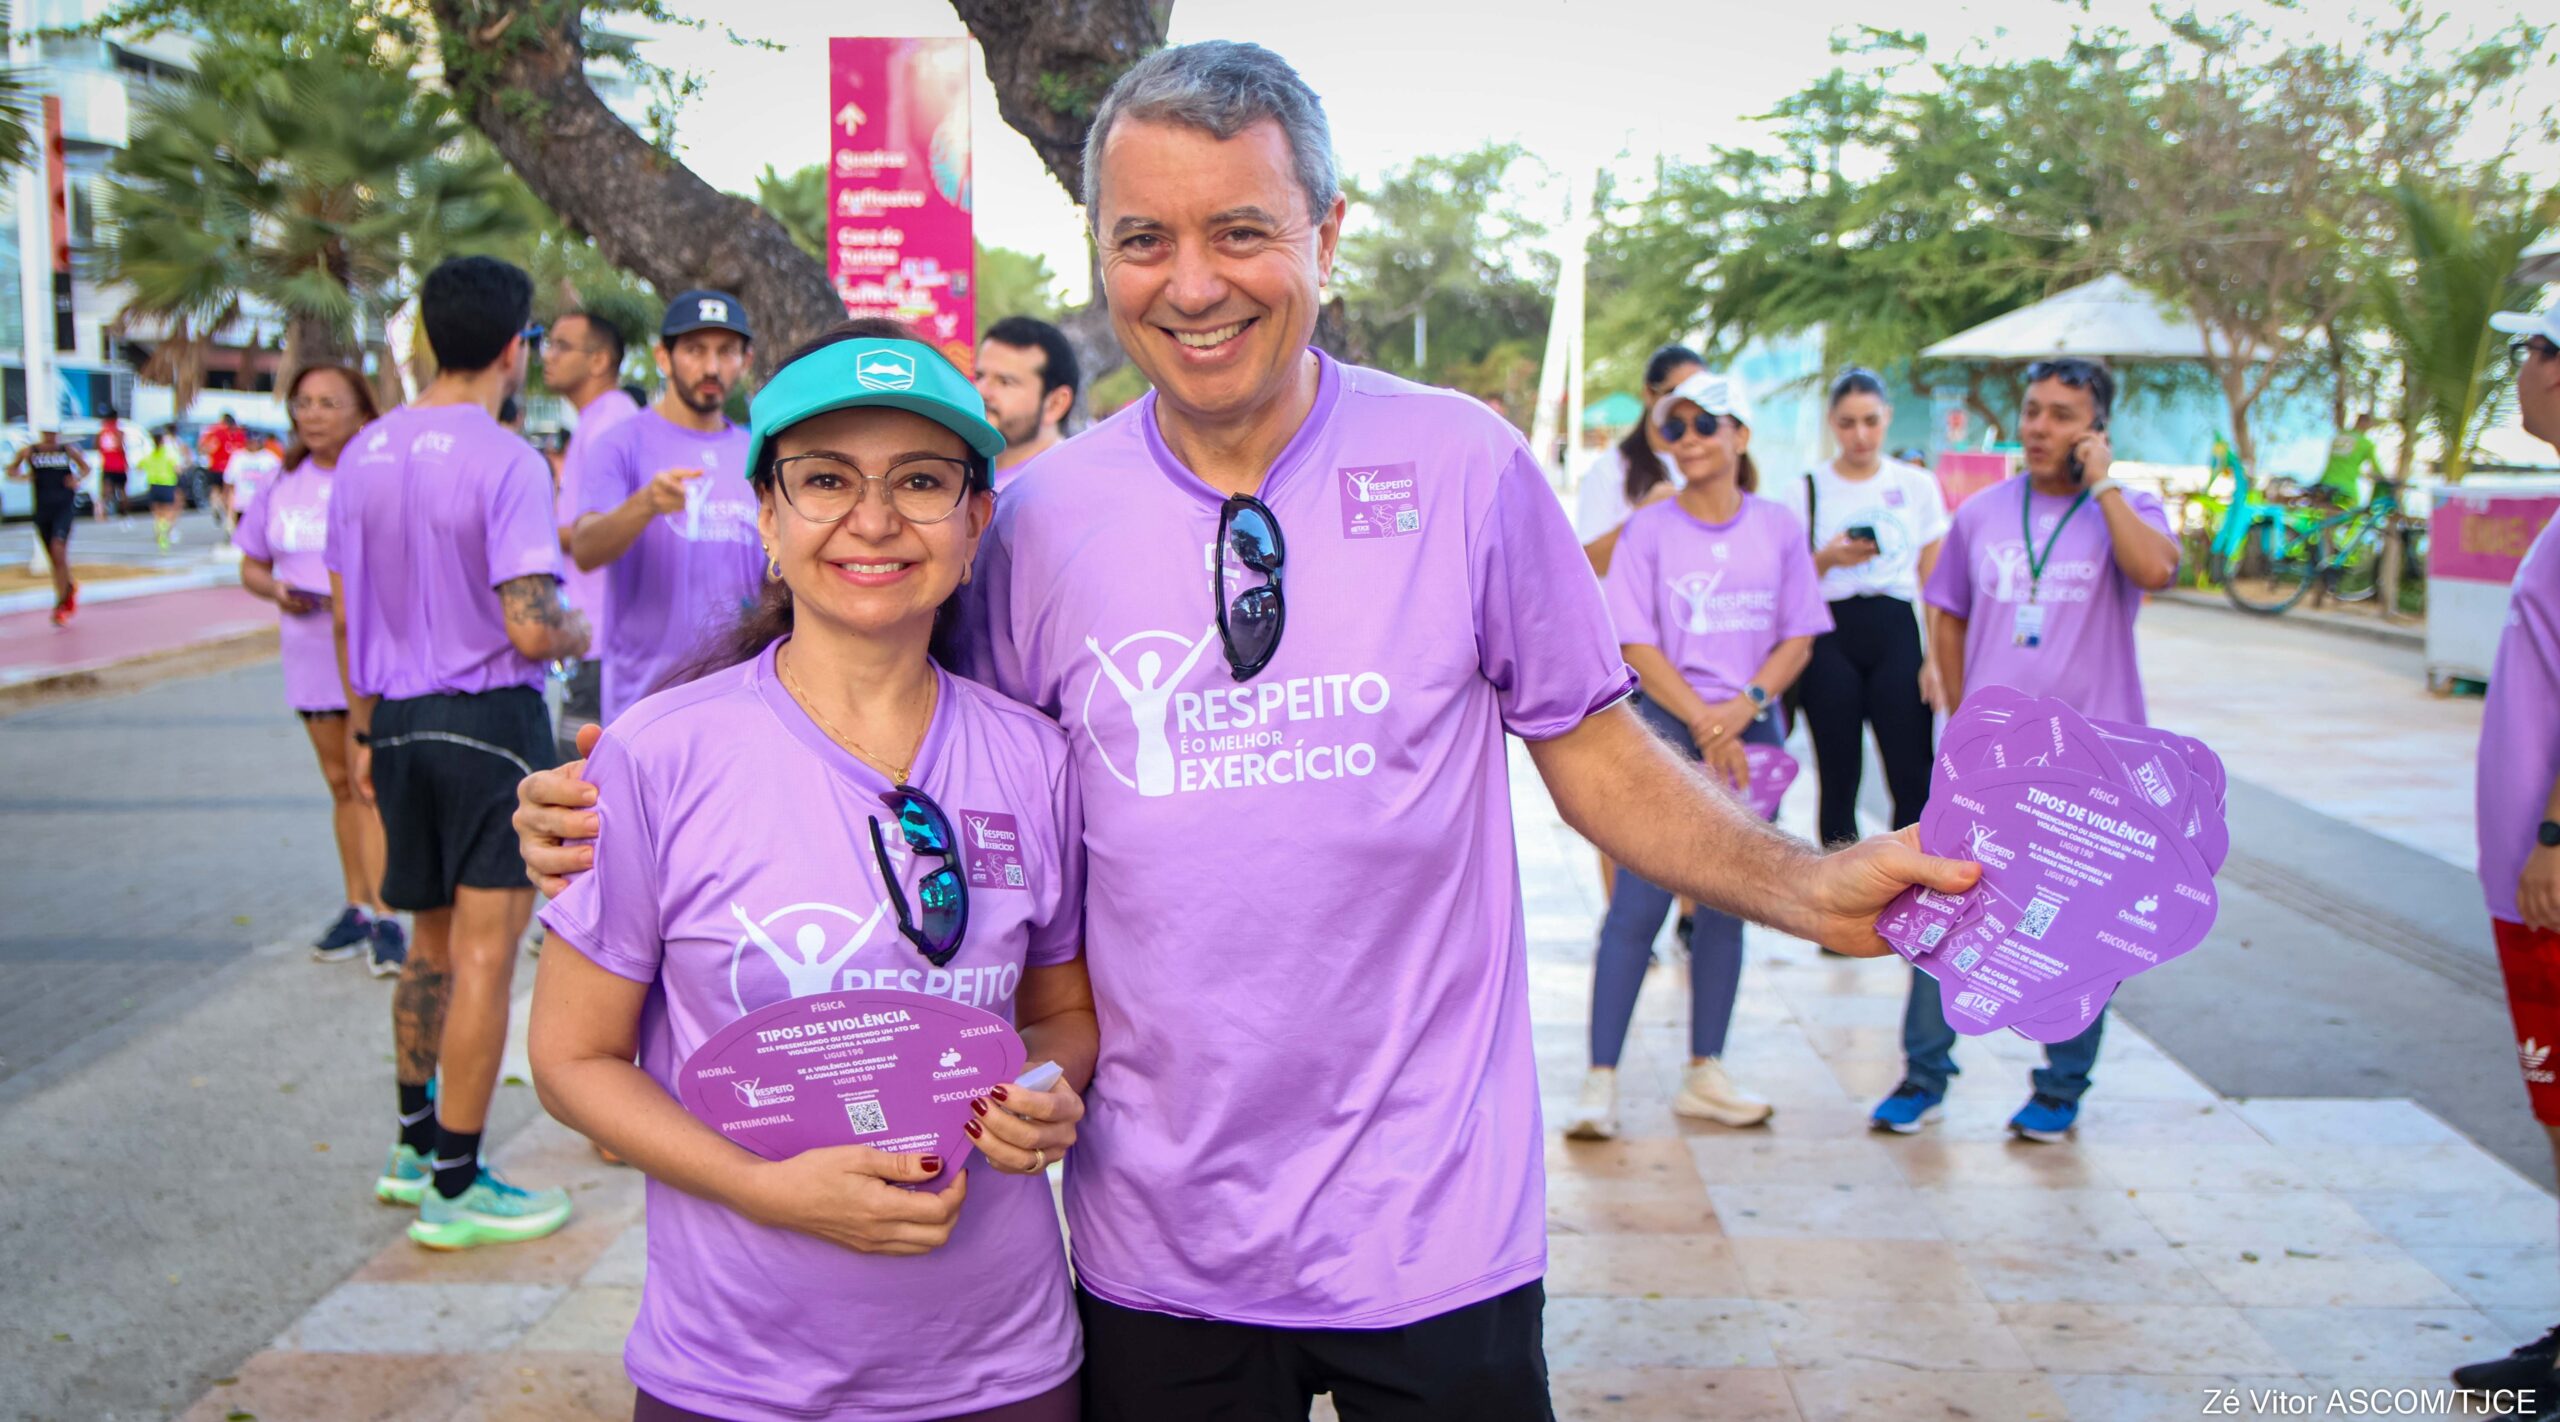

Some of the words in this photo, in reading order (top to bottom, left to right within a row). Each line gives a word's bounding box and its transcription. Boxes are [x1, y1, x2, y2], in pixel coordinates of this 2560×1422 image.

[1369, 480, 1413, 491] RESPEITO
[1175, 671, 1391, 733] RESPEITO
[1180, 735, 1189, 754] É
[1191, 738, 1206, 753] O
[1210, 730, 1284, 752] MELHOR
[2049, 715, 2067, 758] MORAL
[1179, 739, 1376, 792] EXERCÍCIO
[1940, 752, 1959, 781] XUAL
[1951, 793, 1986, 815] MORAL
[2088, 787, 2120, 807] FÍSICA
[2026, 787, 2067, 813] TIPOS
[2066, 803, 2088, 822] DE
[2087, 810, 2157, 850] VIOLÊNCIA
[984, 829, 1016, 841] RESPEITO
[1981, 840, 2016, 860] RESPEITO
[2059, 840, 2080, 854] LIGUE
[2043, 868, 2065, 882] LIGUE
[2173, 883, 2212, 906] SEXUAL
[1984, 911, 2006, 934] PEITO
[2118, 908, 2158, 931] Ouvidoria
[2095, 930, 2158, 964] PSICOLÓGICA
[842, 961, 1019, 1007] RESPEITO
[1971, 970, 1999, 988] OLÊNCIA
[810, 1000, 846, 1013] FÍSICA
[1972, 993, 2001, 1016] TJCE
[756, 1026, 803, 1044] TIPOS
[804, 1022, 827, 1036] DE
[827, 1009, 911, 1033] VIOLÊNCIA
[960, 1024, 1004, 1039] SEXUAL
[756, 1045, 775, 1055] ESTÁ
[775, 1037, 829, 1052] PRESENCIANDO
[830, 1035, 841, 1043] OU
[842, 1031, 880, 1042] SOFRENDO
[881, 1028, 894, 1036] UM
[910, 1023, 920, 1031] DE
[787, 1045, 826, 1057] VIOLÊNCIA
[826, 1041, 856, 1051] CONTRA
[862, 1035, 894, 1046] MULHER:
[814, 1060, 852, 1072] VIOLÊNCIA
[852, 1056, 886, 1067] OCORREU
[887, 1054, 898, 1062] HÁ
[823, 1051, 848, 1061] LIGUE
[848, 1048, 864, 1057] 190
[697, 1065, 736, 1079] MORAL
[805, 1070, 839, 1081] ALGUMAS
[839, 1067, 865, 1076] HORAS
[865, 1064, 876, 1072] OU
[833, 1077, 857, 1086] LIGUE
[857, 1073, 874, 1082] 180
[932, 1065, 978, 1079] Ouvidoria
[755, 1083, 795, 1097] RESPEITO
[932, 1085, 994, 1104] PSICOLÓGI
[722, 1113, 795, 1132] PATRIMONIAL
[876, 1133, 932, 1147] DESCUMPRINDO
[888, 1144, 898, 1152] DE
[898, 1139, 938, 1151] URGÊNCIA?
